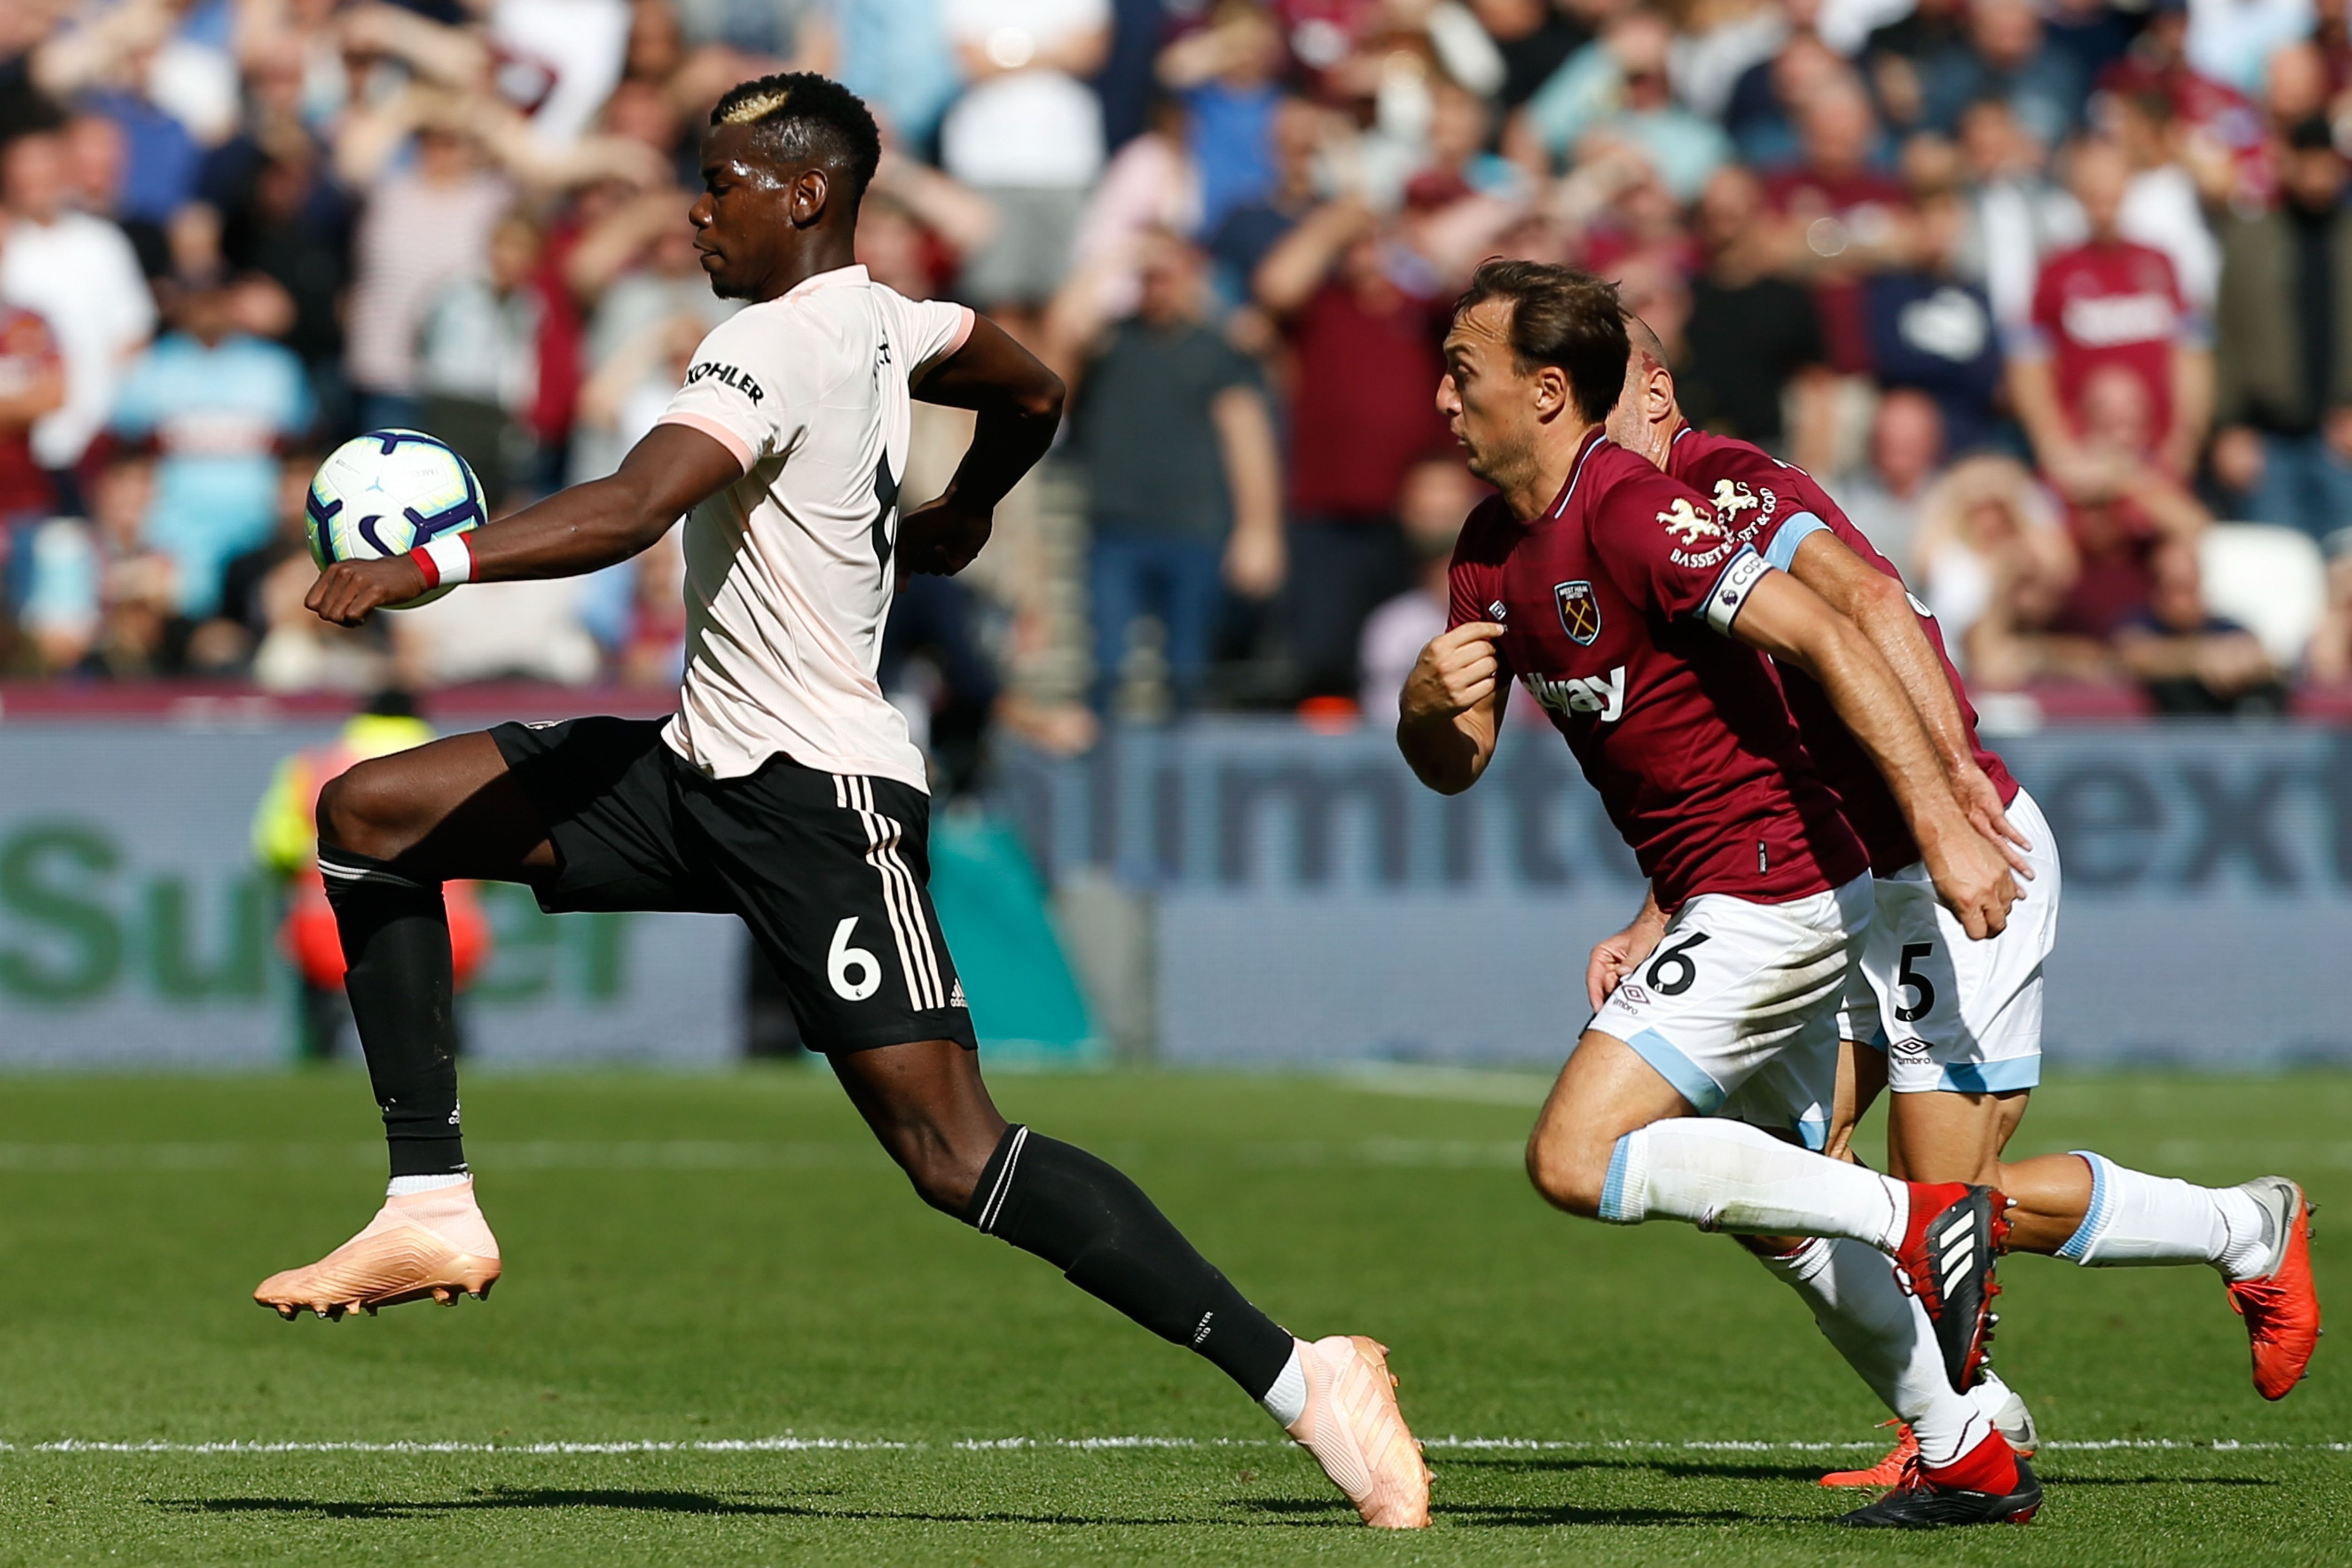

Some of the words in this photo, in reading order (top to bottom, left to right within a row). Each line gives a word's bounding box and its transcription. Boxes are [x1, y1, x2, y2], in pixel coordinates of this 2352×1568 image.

[685, 362, 764, 408] KOHLER
[1670, 548, 1724, 568] BASSET
[0, 818, 632, 1004] Suer
[827, 916, 882, 1002] 6
[1895, 942, 1935, 1022] 5
